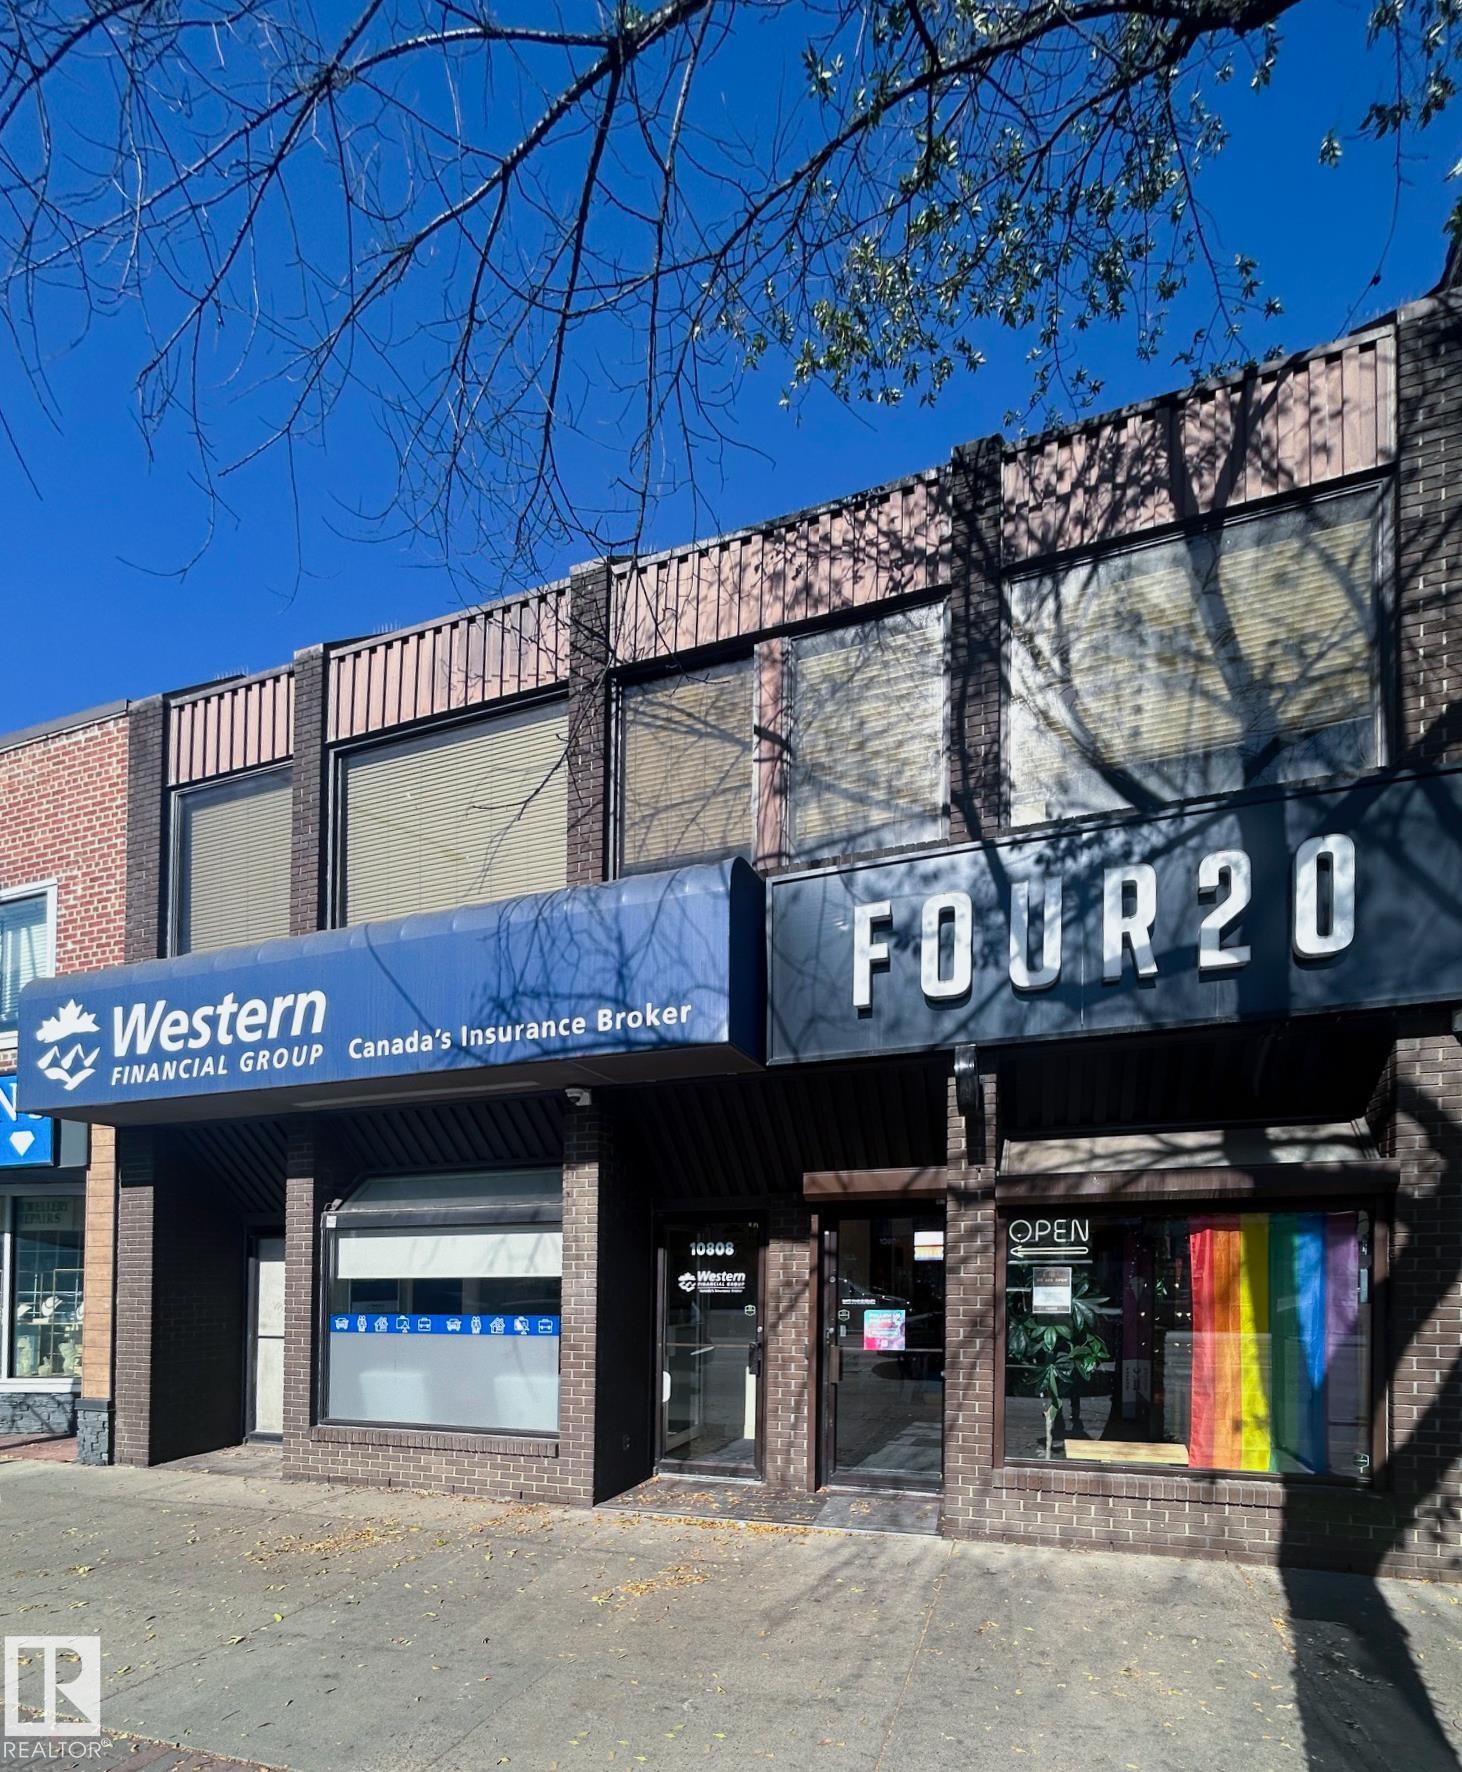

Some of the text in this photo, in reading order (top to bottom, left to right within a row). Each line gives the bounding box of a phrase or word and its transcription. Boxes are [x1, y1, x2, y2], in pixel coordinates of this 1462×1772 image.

[113, 989, 327, 1057] Western
[348, 1002, 692, 1060] Canada's Insurance Broker
[111, 1043, 324, 1086] FINANCIAL GROUP
[1009, 1219, 1089, 1243] OPEN
[690, 1242, 735, 1256] 10808
[697, 1270, 746, 1281] Western
